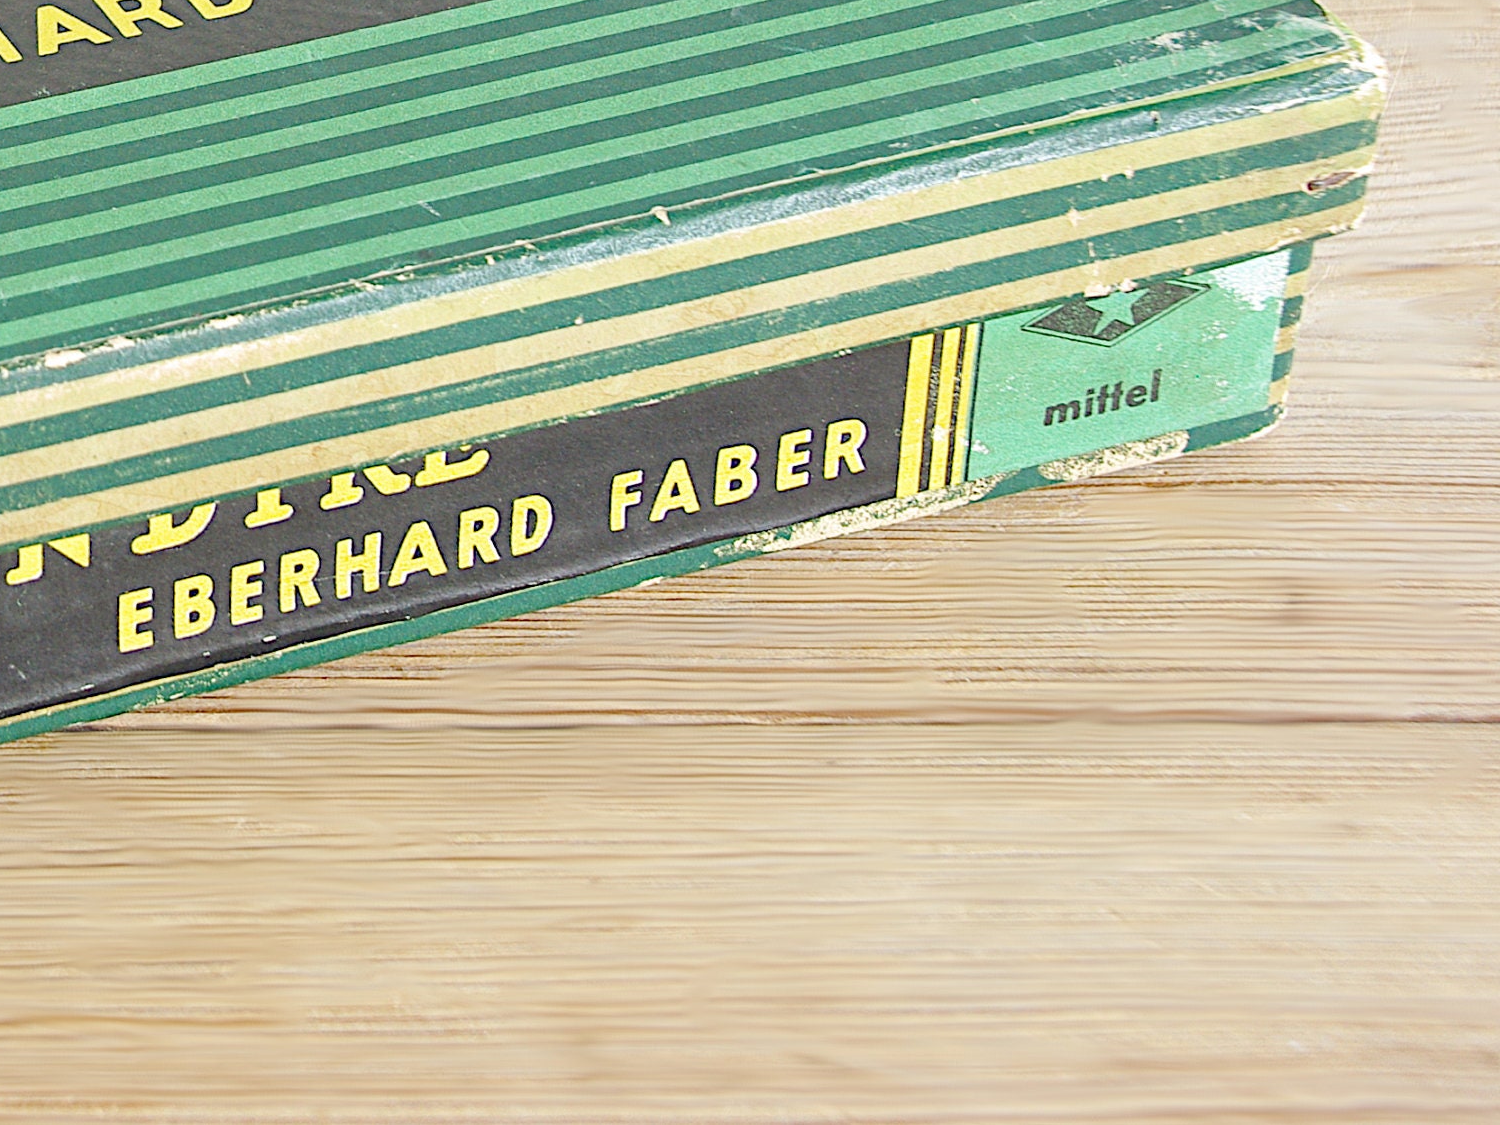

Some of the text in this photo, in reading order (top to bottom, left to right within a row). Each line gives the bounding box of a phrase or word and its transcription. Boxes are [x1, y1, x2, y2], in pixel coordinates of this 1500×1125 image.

[1043, 368, 1163, 426] mittel
[117, 493, 556, 654] EBERHARD
[608, 417, 868, 533] FABER
